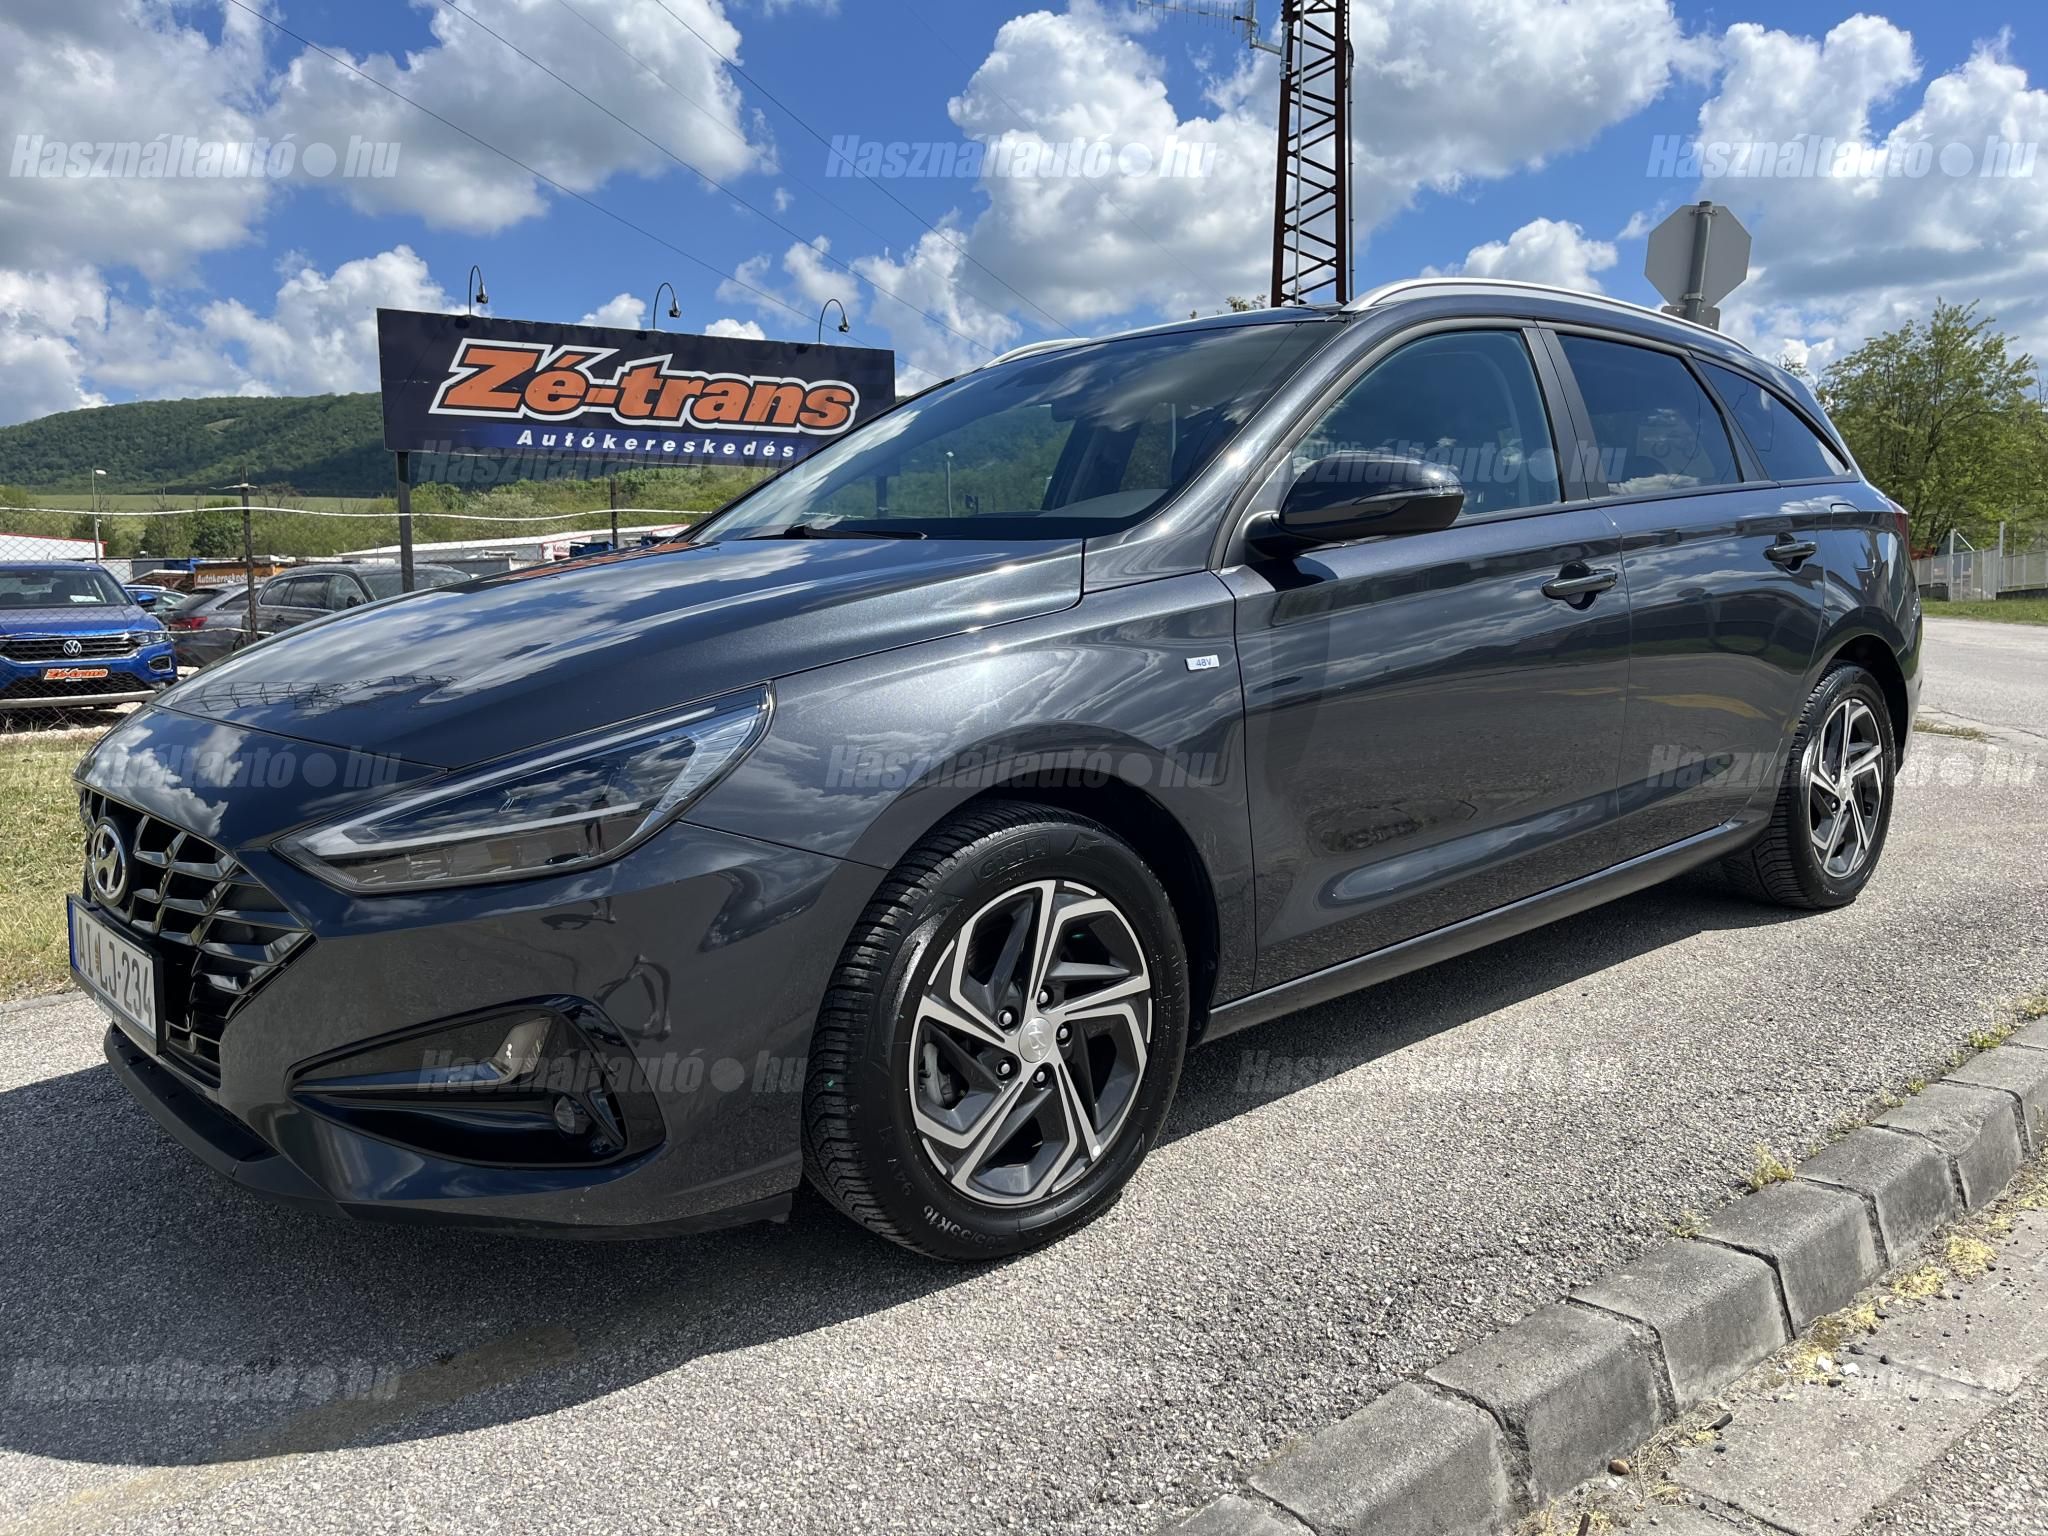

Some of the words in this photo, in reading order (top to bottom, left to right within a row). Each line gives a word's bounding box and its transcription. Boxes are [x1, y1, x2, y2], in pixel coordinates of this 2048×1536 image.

[436, 342, 857, 430] Zé-trans
[516, 429, 795, 459] Autókereskedés
[1196, 657, 1212, 667] 48V
[78, 915, 94, 978] AI
